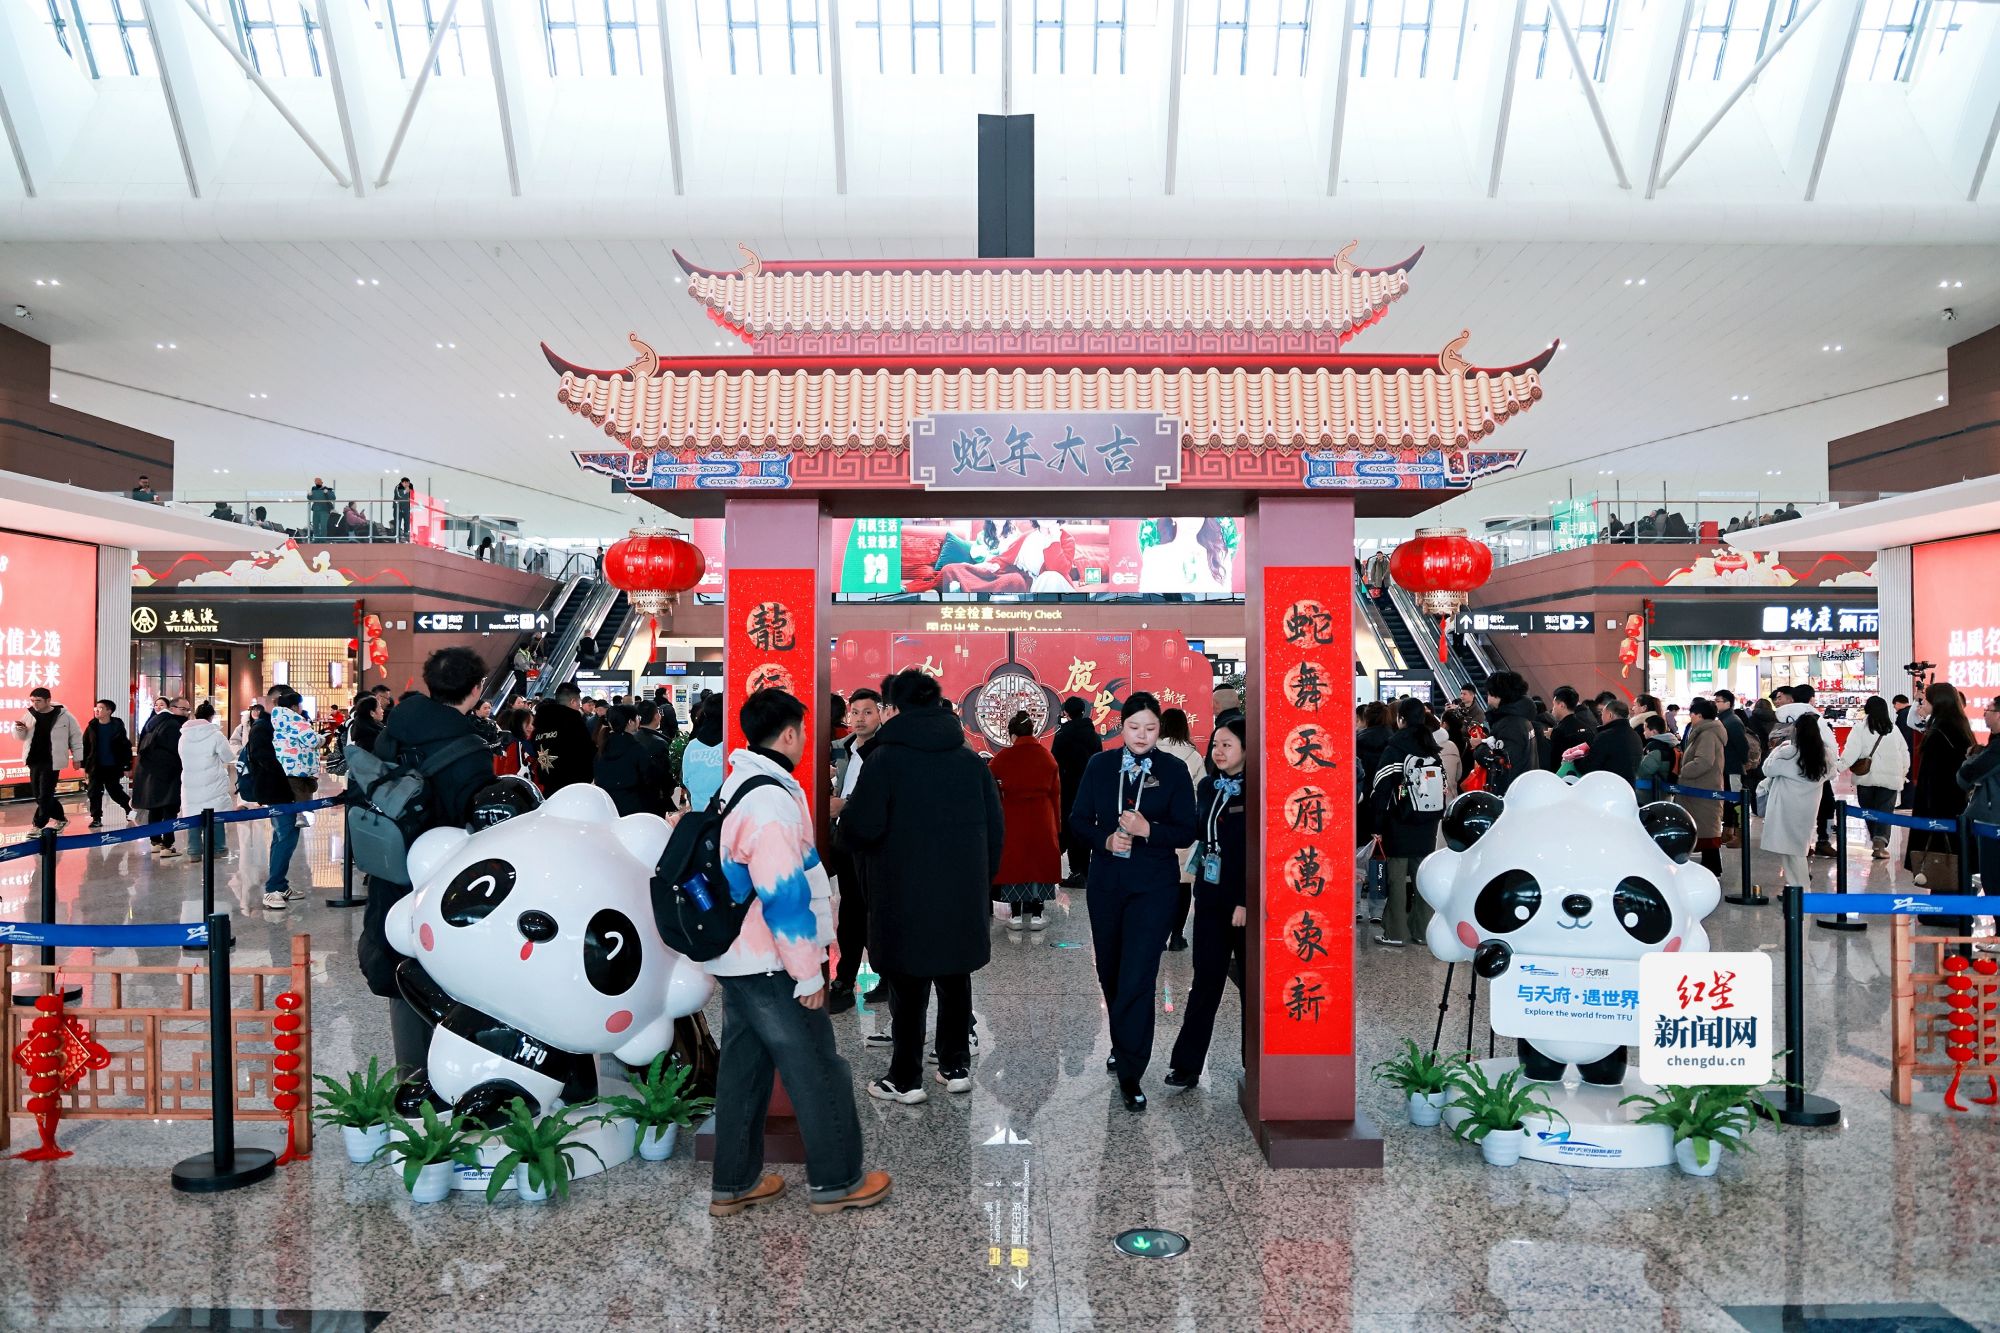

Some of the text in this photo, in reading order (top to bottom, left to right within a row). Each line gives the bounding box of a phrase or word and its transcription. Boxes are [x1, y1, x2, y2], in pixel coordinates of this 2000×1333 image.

[951, 424, 1140, 477] 蛇年大吉
[164, 607, 219, 624] 五粮液
[448, 614, 464, 623] 商店
[503, 614, 520, 623] 餐饮
[940, 606, 1062, 621] 安全检查 Security Check
[1489, 615, 1505, 624] 餐饮
[1544, 615, 1559, 624] 商店
[1218, 663, 1232, 675] 13
[1285, 604, 1336, 1024] 蛇舞天府萬象新
[1524, 1007, 1633, 1021] Explore the world from TFU
[519, 1042, 548, 1066] TFU
